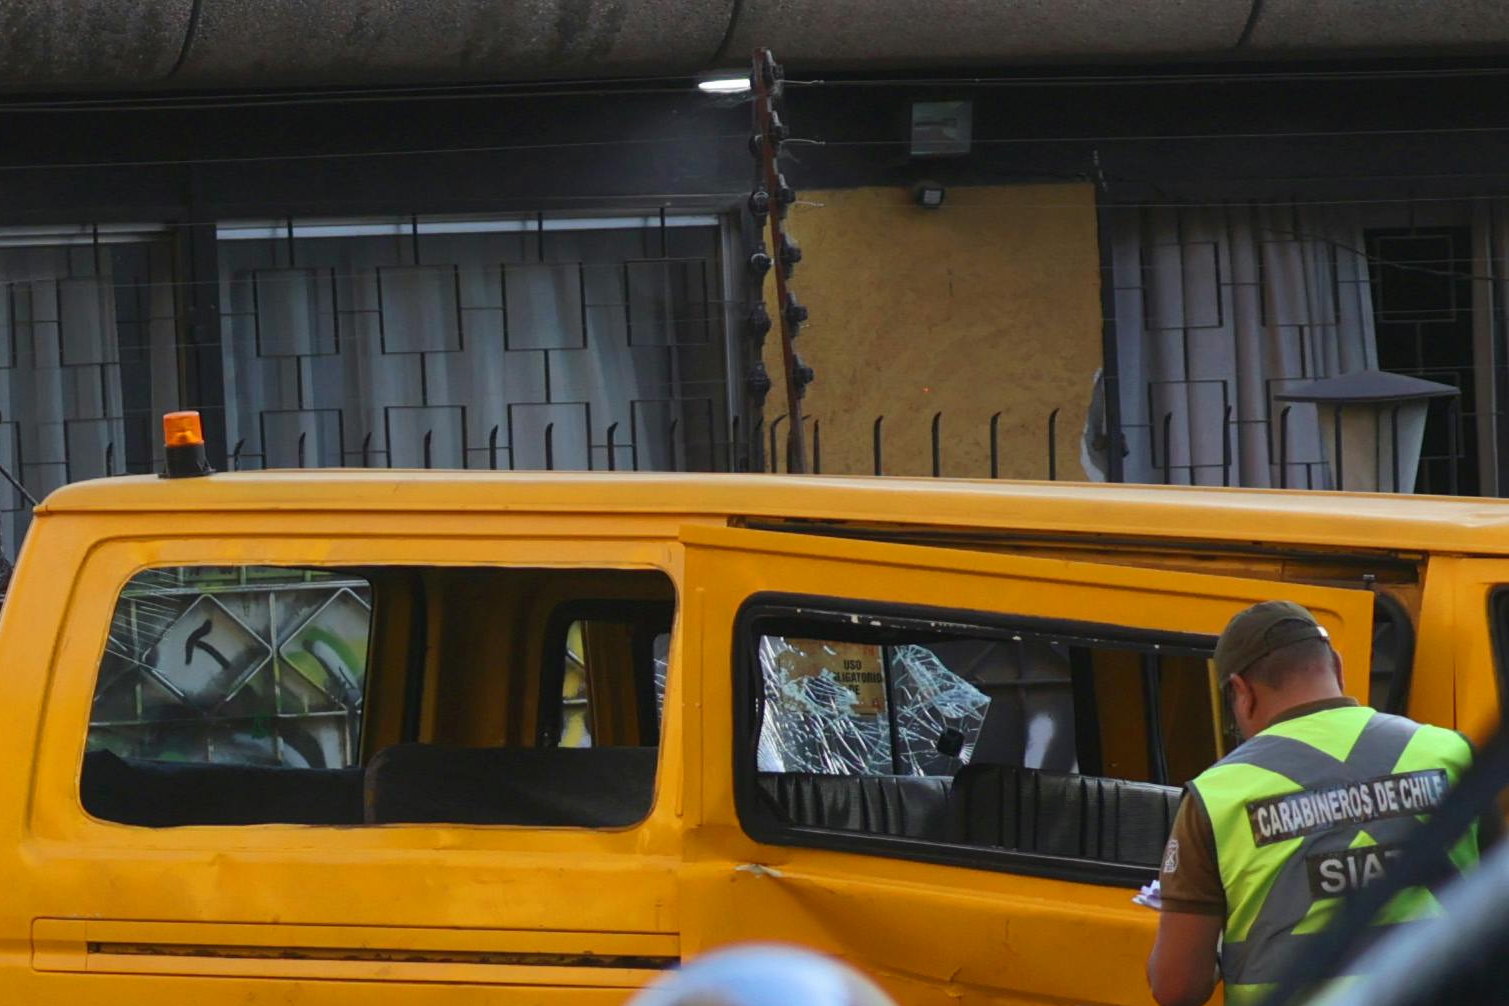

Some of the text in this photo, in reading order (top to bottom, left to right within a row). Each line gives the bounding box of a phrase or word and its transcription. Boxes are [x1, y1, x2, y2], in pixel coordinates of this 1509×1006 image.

[843, 660, 862, 670] USO
[1257, 775, 1443, 837] CARABINEROS DE CHILE
[1319, 851, 1398, 893] SIA
